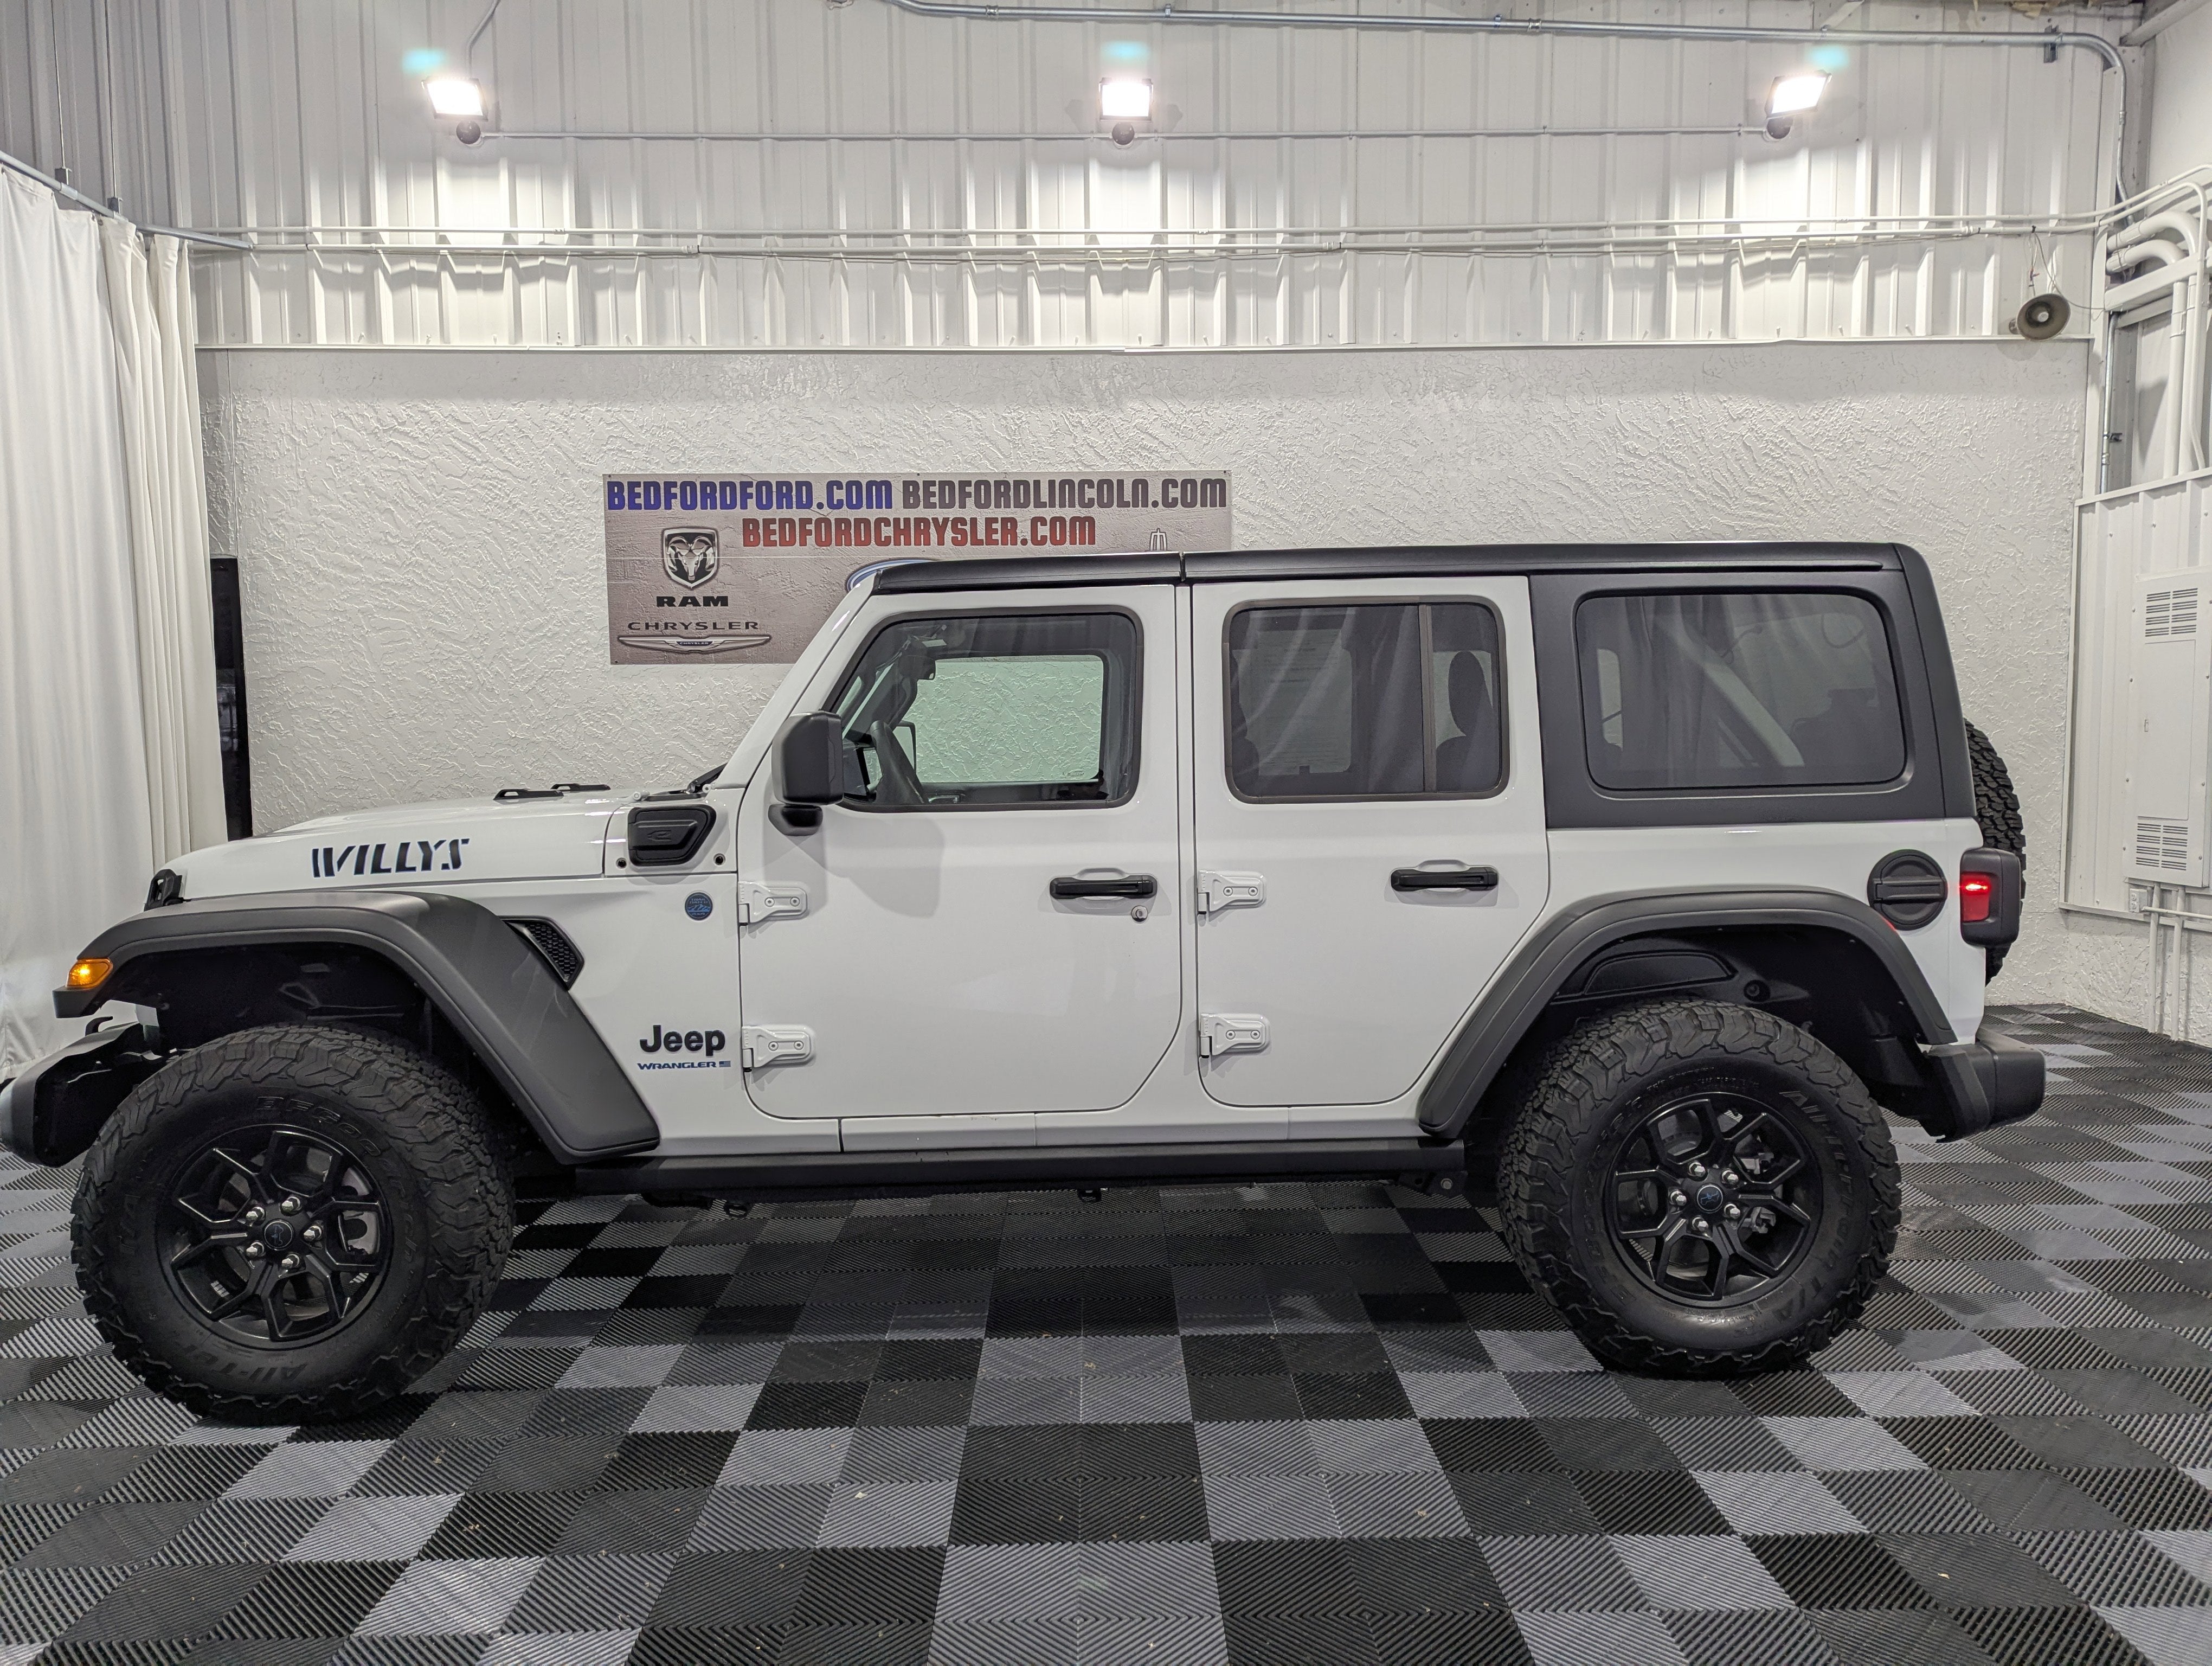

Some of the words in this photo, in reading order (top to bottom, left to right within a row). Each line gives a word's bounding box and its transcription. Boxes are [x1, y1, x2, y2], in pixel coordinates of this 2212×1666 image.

[607, 480, 893, 511] BEDFORDFORD.COM
[902, 478, 1227, 509] BEDFORDLINCOLN.COM
[742, 516, 1096, 547] BEDFORDCHRYSLER.COM
[656, 595, 728, 607] RAM
[628, 621, 759, 630] CHRYSLER
[312, 838, 470, 878] WILLYS
[639, 1024, 725, 1056] Jeep
[637, 1061, 717, 1071] WRANGLER
